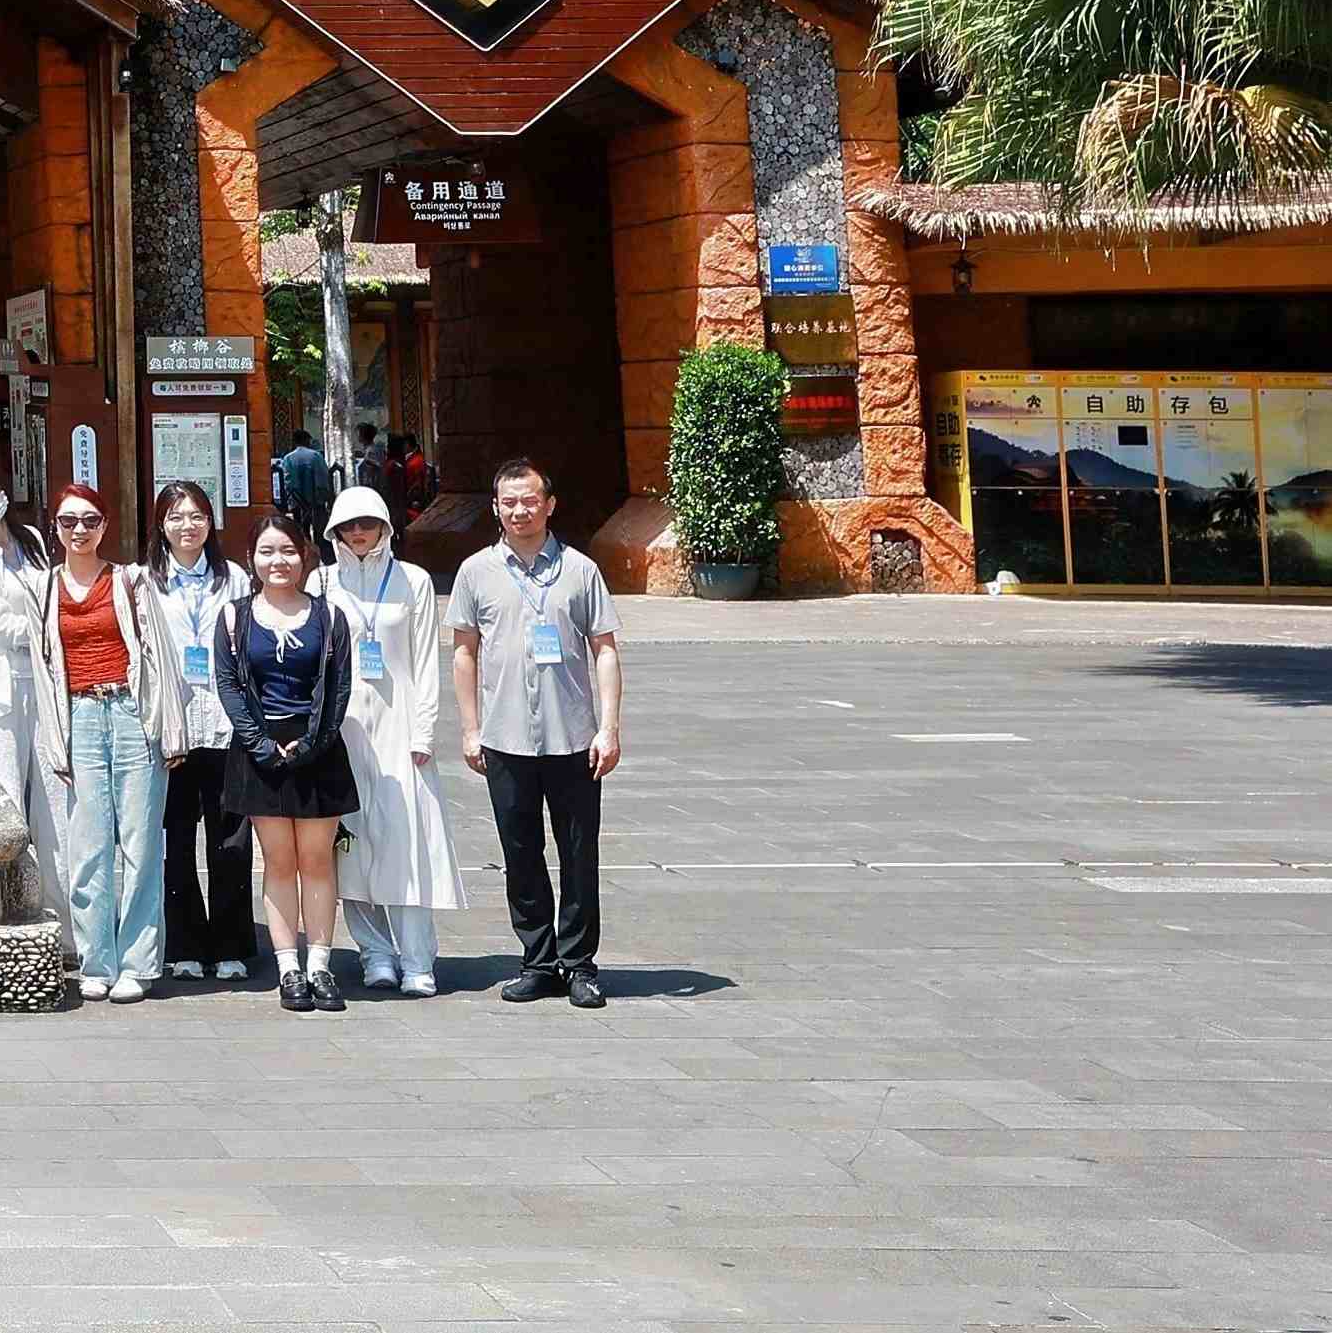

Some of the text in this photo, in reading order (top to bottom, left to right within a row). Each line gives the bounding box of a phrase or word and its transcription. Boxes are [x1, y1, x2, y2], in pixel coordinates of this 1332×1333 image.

[404, 180, 506, 201] 备用通道
[410, 201, 501, 212] Contingency Passage
[414, 211, 468, 223] Аварийный
[168, 338, 233, 355] 槟榔谷
[1085, 393, 1230, 415] 自助存包
